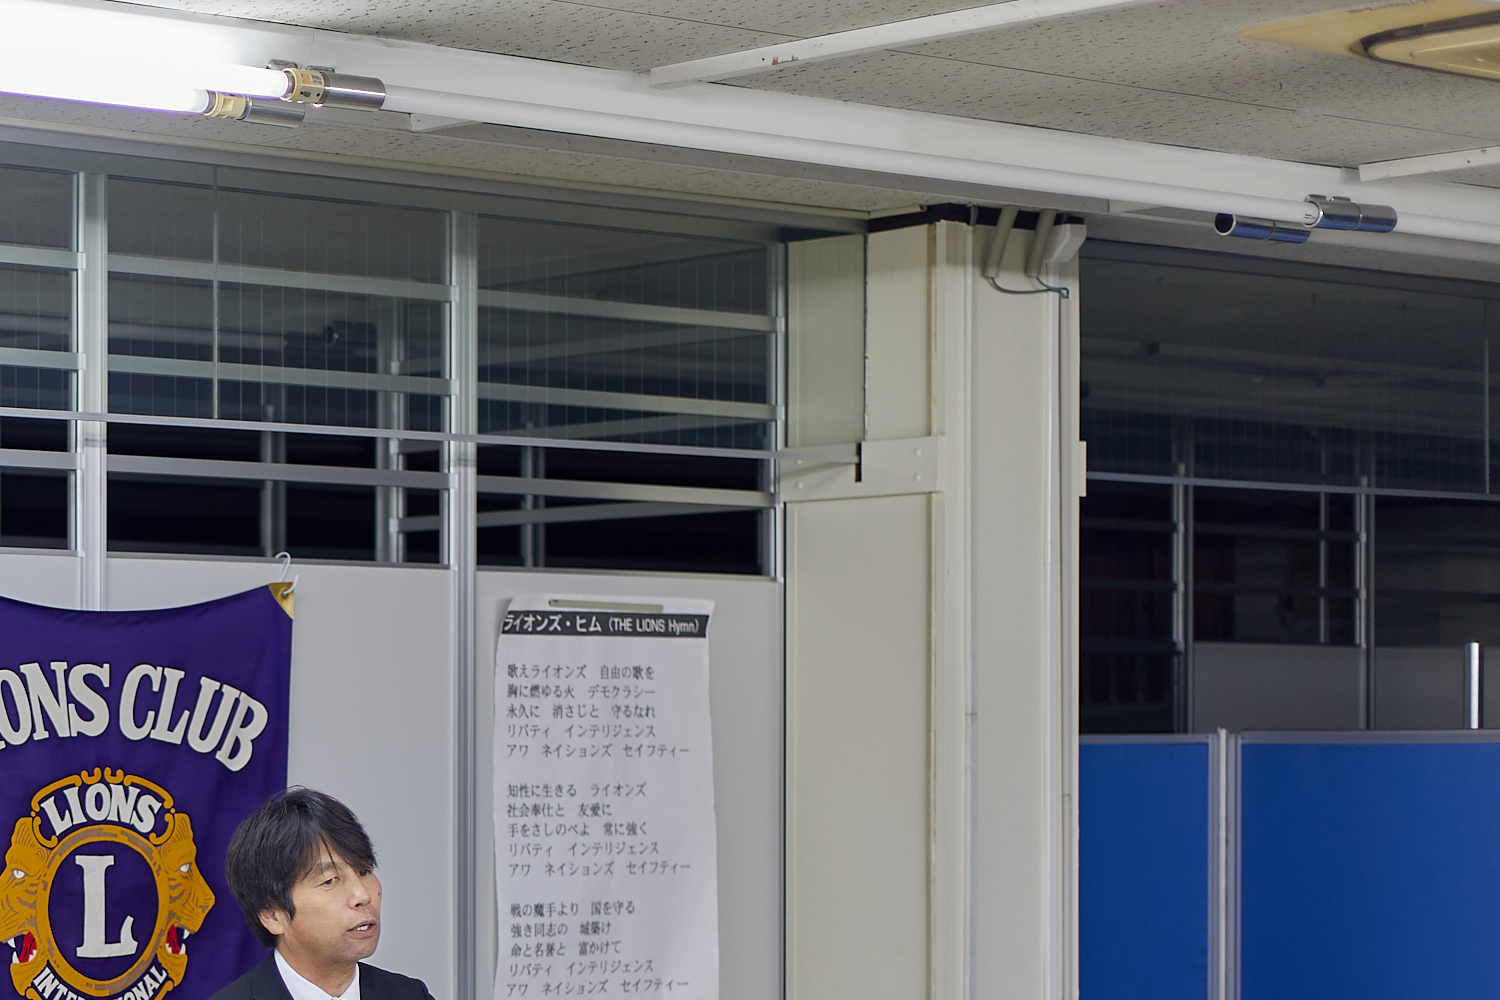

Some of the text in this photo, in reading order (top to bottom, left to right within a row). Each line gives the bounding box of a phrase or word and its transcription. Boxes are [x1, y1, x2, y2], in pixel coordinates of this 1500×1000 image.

[503, 614, 602, 633] ライオンズ・ヒム
[637, 618, 665, 633] LIONS
[508, 664, 654, 680] 歌えライオンズ 自由の歌を
[507, 684, 654, 698] 胸に燃ゆる火 デモクラシー
[119, 663, 269, 773] CLUB
[507, 703, 655, 719] 永久に 消さじと 守るなれ
[565, 724, 655, 738] インテリジェンス
[507, 743, 689, 758] アワ ネイションズ セイフティー
[508, 782, 646, 798] 知性に生きる ライオンズ
[40, 782, 162, 836] LIONS
[507, 802, 612, 818] 社会奉仕と 友愛に
[603, 822, 646, 836] 常に強く
[569, 842, 658, 856] インテリジェンス
[509, 861, 690, 876] アワ ネイションズ セイフティー
[75, 854, 138, 958] L
[591, 900, 634, 915] 国を守る
[511, 922, 568, 938] 強き同志の
[511, 941, 621, 957] 命と名誉と 富かけて
[567, 960, 653, 975] インテリジェンス
[507, 978, 688, 996] アワ ネイションズ セイフティー
